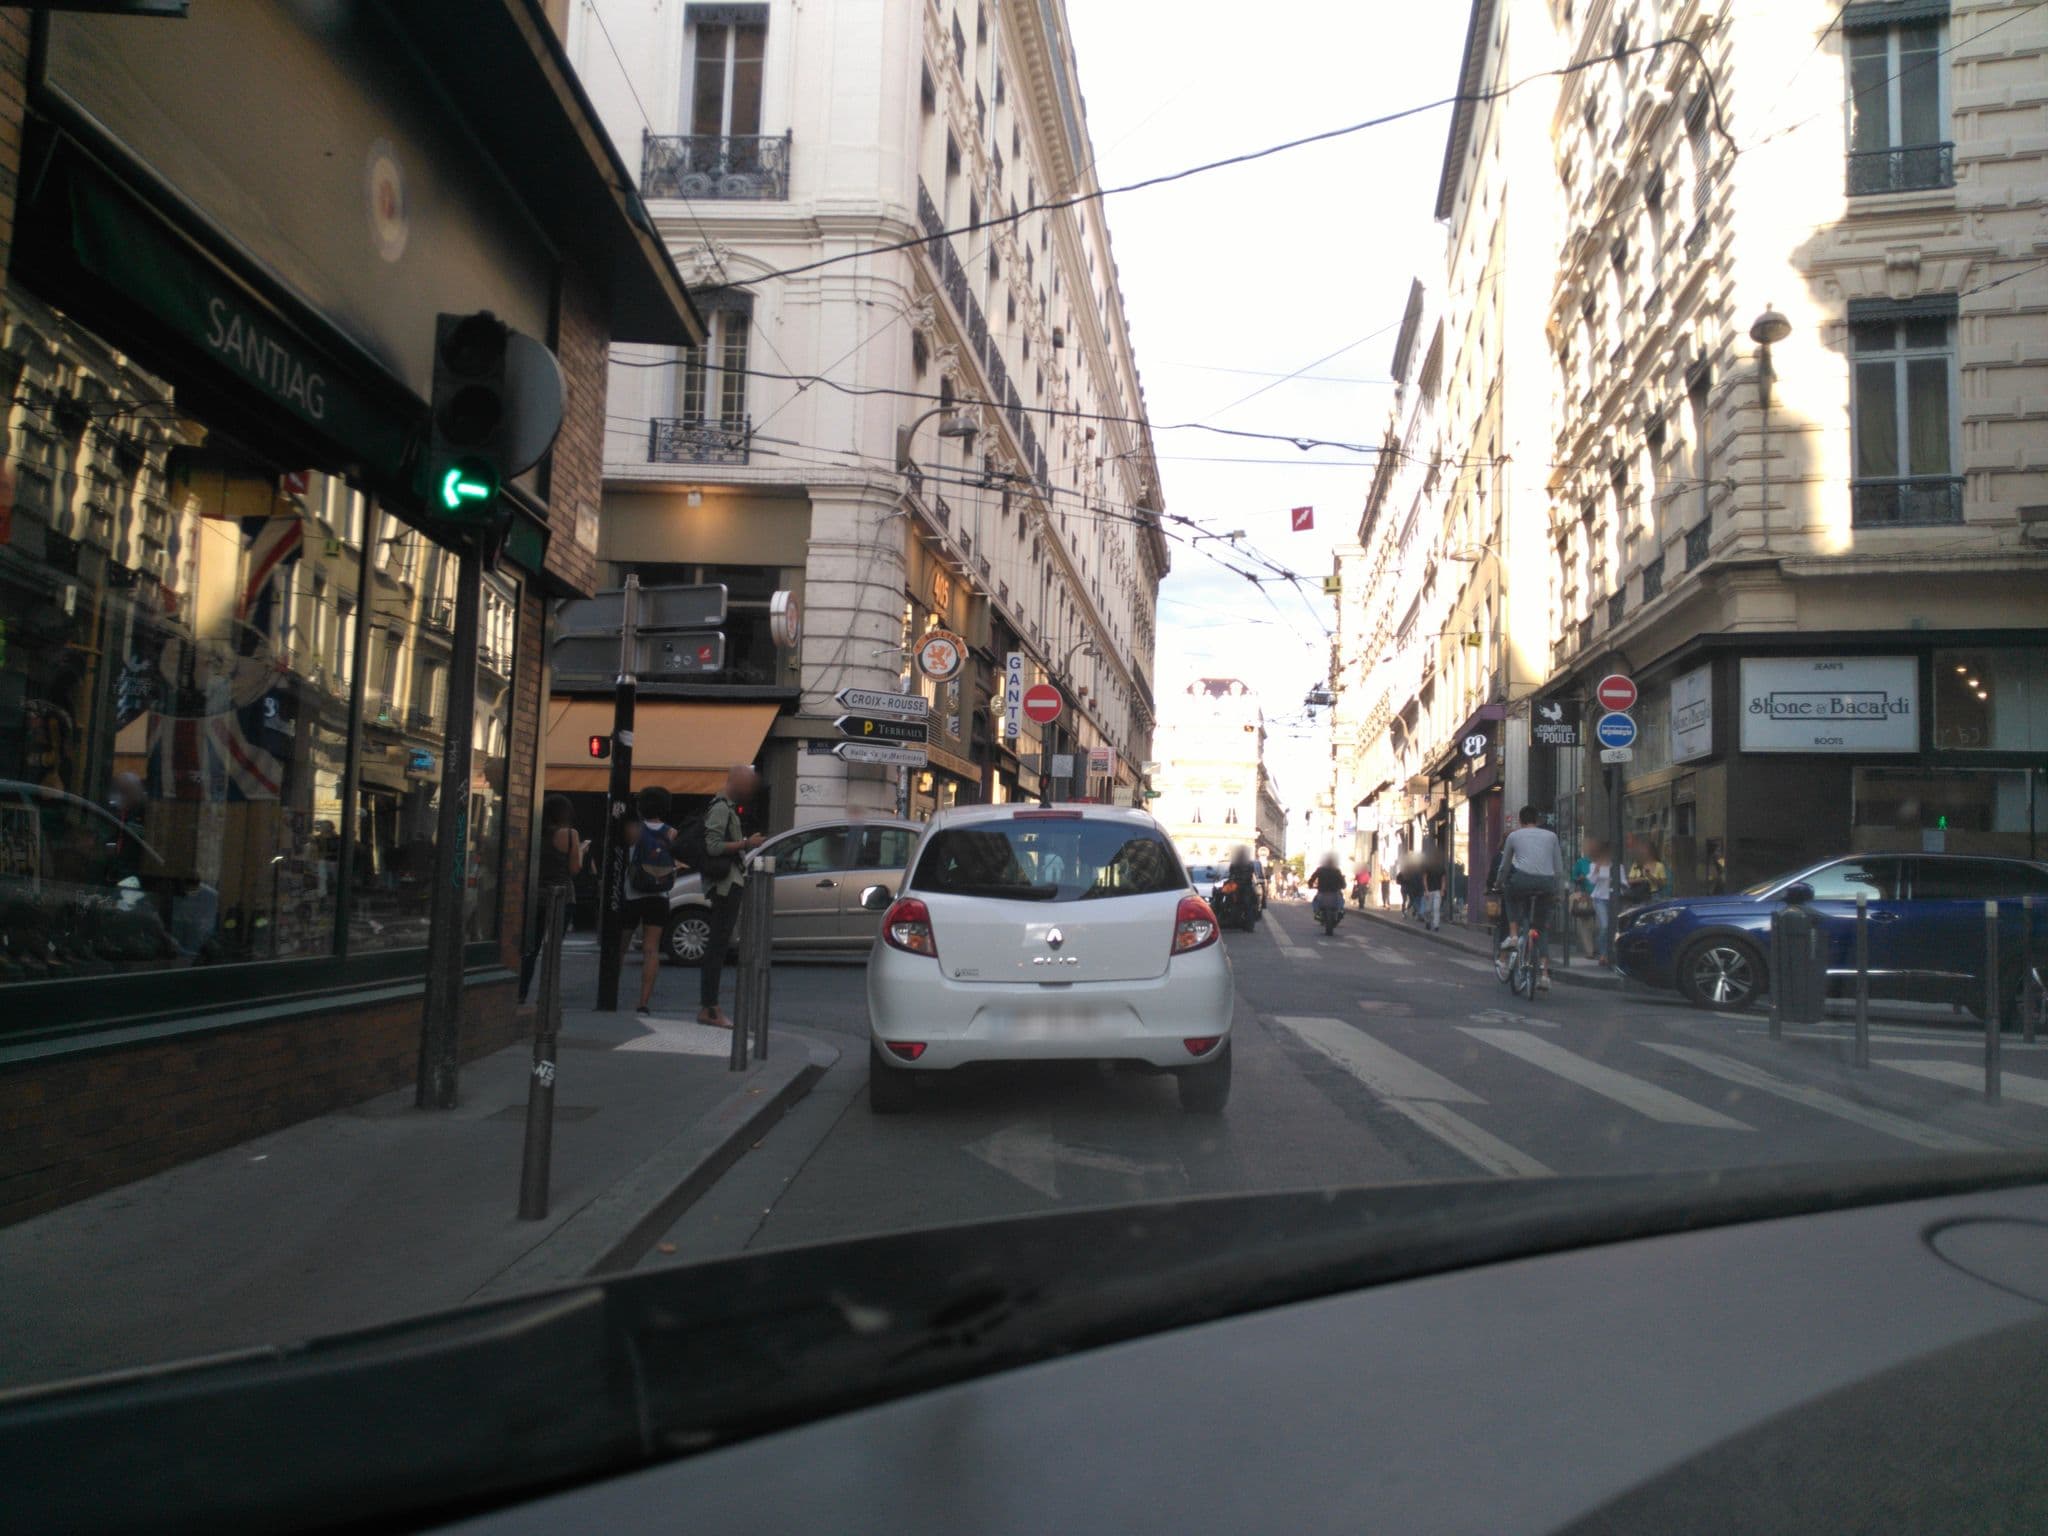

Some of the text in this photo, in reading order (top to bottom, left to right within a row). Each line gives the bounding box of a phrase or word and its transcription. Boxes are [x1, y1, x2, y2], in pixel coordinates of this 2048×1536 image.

[206, 298, 326, 419] SANTIAG
[1008, 656, 1021, 735] GANTS
[1749, 698, 1812, 714] Shone
[1830, 697, 1911, 714] Bacardi
[1543, 732, 1576, 743] POULET
[1814, 737, 1844, 745] BOOTS
